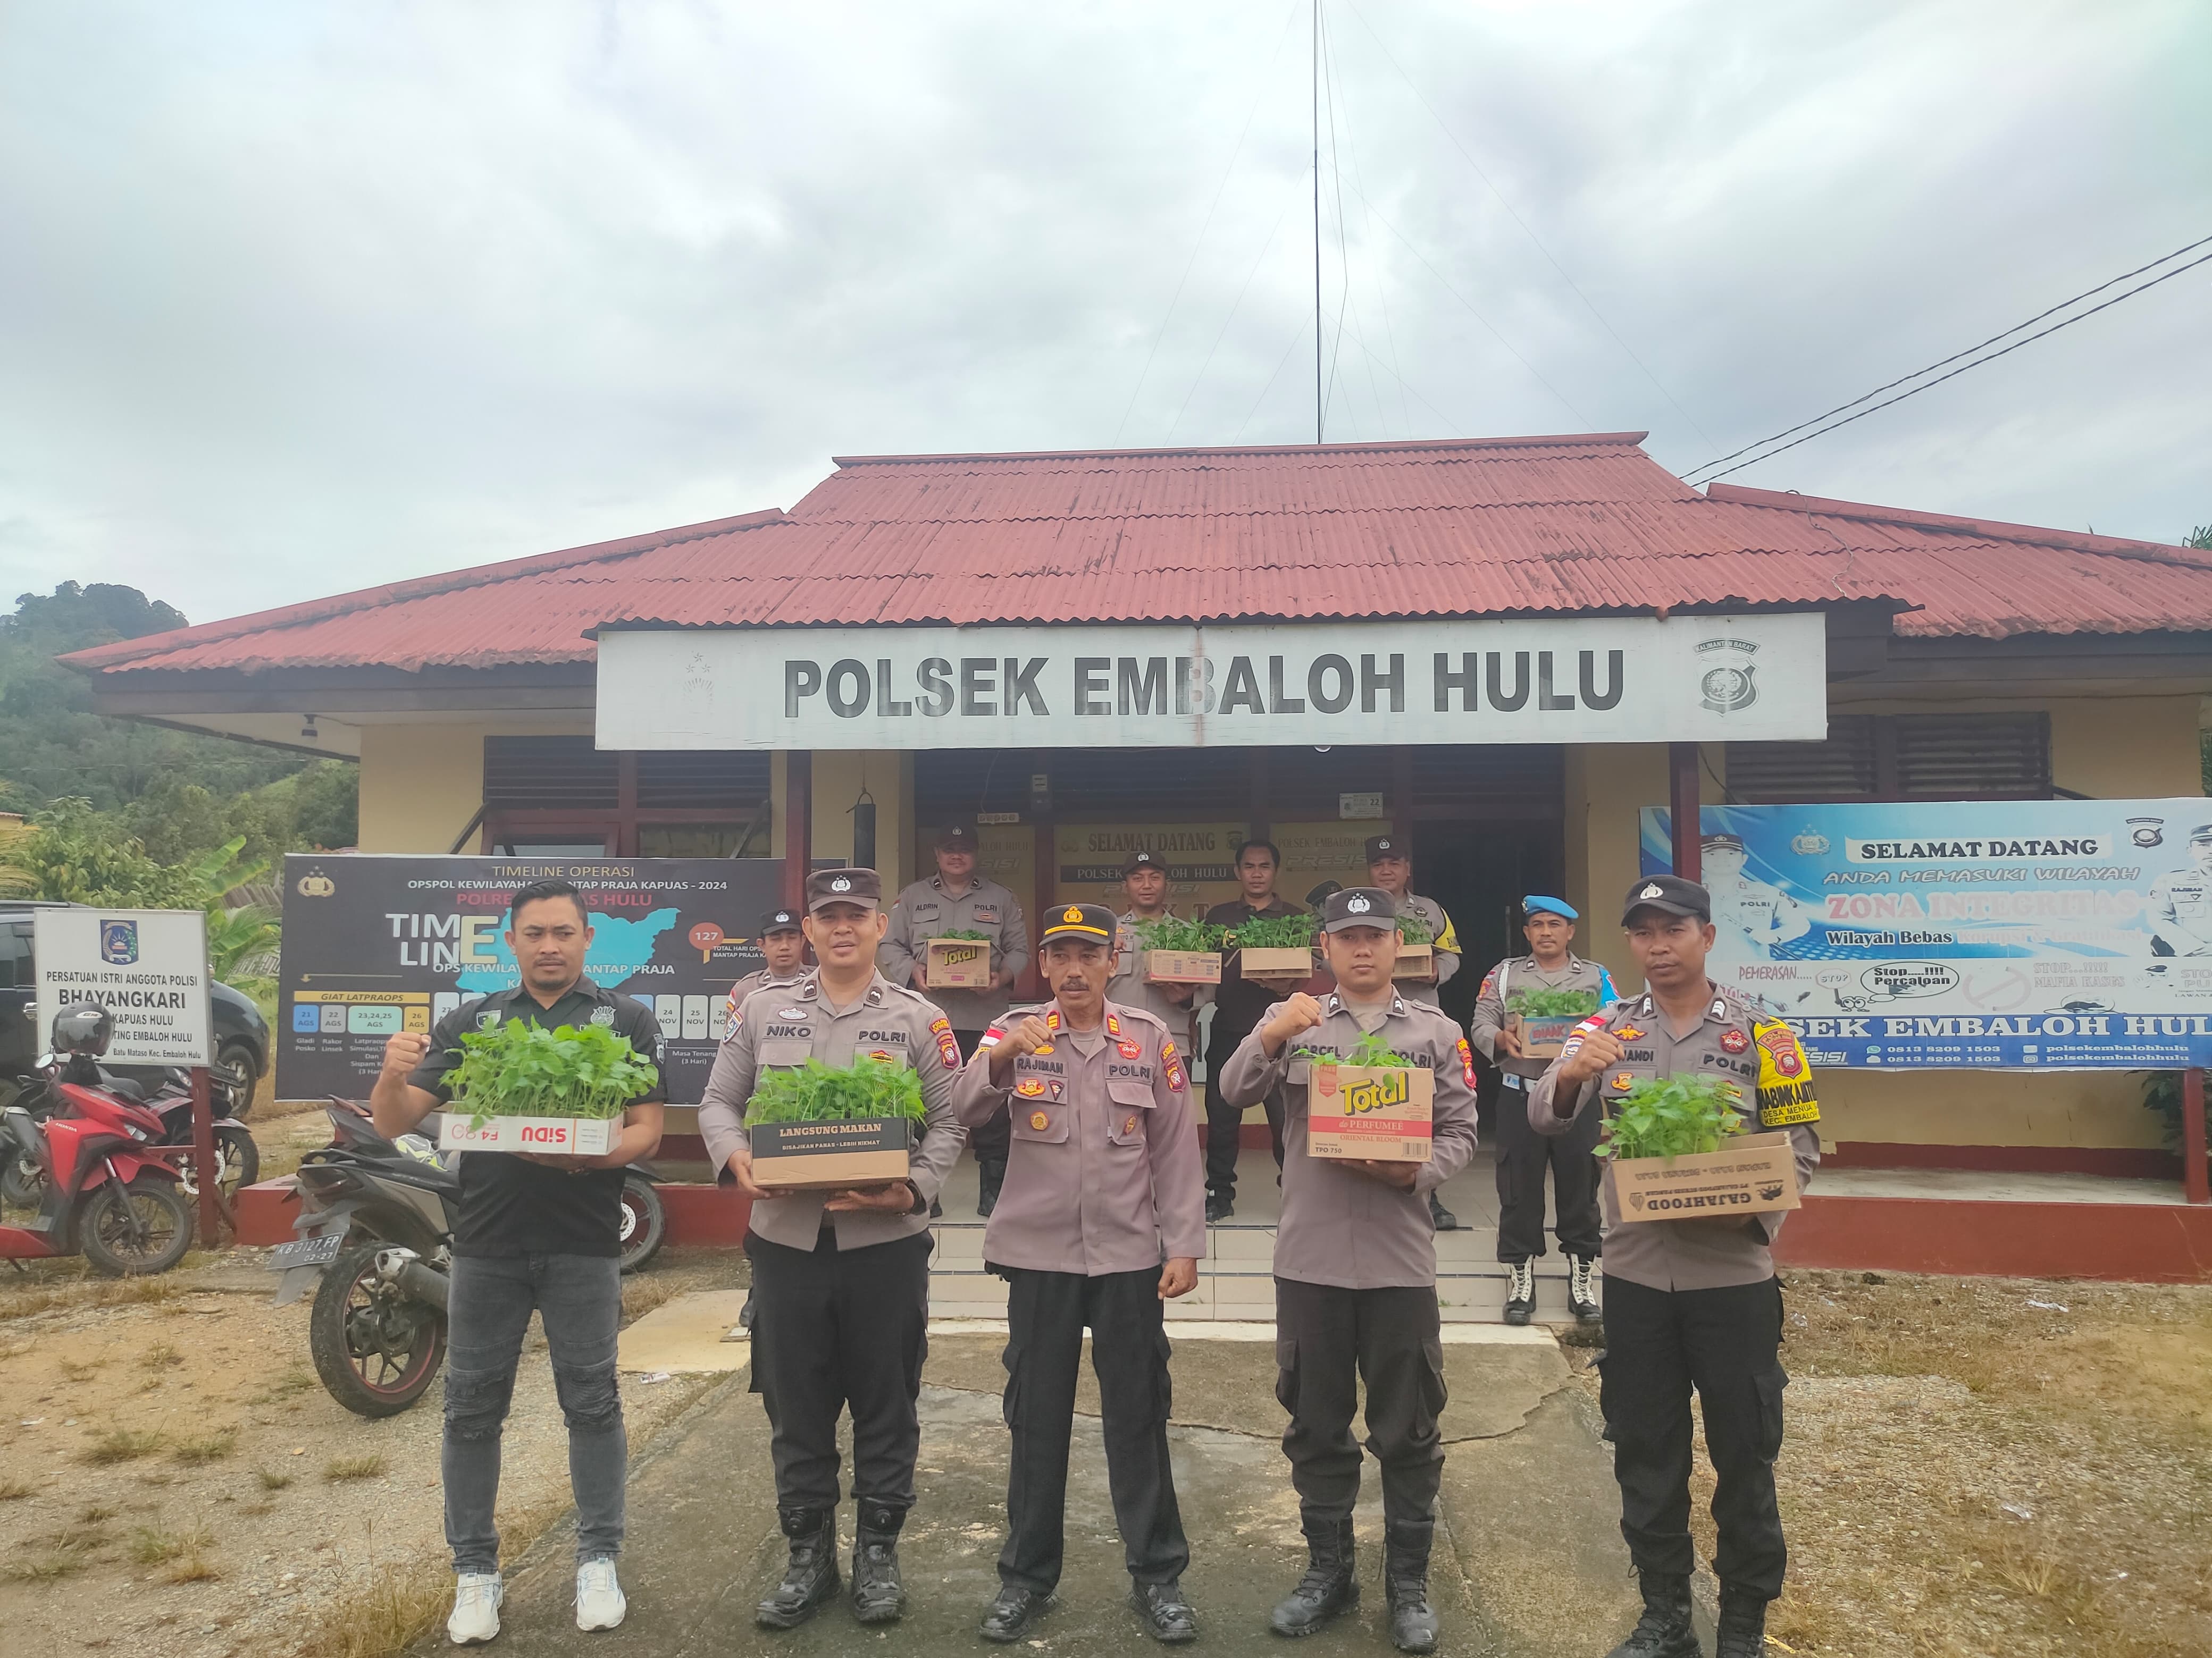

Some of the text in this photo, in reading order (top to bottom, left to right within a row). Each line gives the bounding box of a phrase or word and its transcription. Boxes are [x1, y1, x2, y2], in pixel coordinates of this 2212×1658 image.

[1733, 641, 1754, 651] BARAT
[785, 650, 1623, 719] POLSEK EMBALOH HULU
[1089, 832, 1215, 852] SELAMAT DATANG
[1861, 839, 2098, 859] SELAMAT DATANG
[1287, 854, 1366, 866] PRESIS
[492, 866, 635, 877] TIMELINE OPERASI
[1078, 869, 1123, 879] POLSEK
[1195, 868, 1227, 878] HULU
[1823, 867, 2141, 885] ANDA MEMASUKI WILAYAH
[408, 880, 455, 889] OPSPOL
[458, 880, 532, 889] KEWILAYAH
[601, 881, 638, 890] PRAJA
[641, 881, 689, 890] KAPUAS
[699, 881, 728, 890] 2024
[457, 893, 512, 905] POLRE
[604, 894, 652, 906] HULU
[1828, 891, 2139, 919] ZONA INTEGRITAS
[915, 903, 939, 912] ALDRIN
[695, 932, 718, 940] 127
[1828, 931, 1893, 946] Wilayah
[1900, 931, 1952, 944] Bebas
[942, 946, 977, 966] Total
[433, 964, 460, 973] OPS
[583, 965, 628, 974] ANTAP
[632, 965, 675, 974] PRAJA
[2181, 969, 2212, 979] STO
[47, 971, 198, 987] PERSATUAN ISTRI ANGGOTA POLISI
[1874, 977, 1950, 985] Percaloan
[60, 989, 186, 1009] BHAYANGKARI
[113, 1014, 174, 1026] KAPUAS HULU
[1784, 1015, 2212, 1037] SEK EMBALOH HUL
[113, 1031, 192, 1042] TING EMBALOH HULU
[766, 1025, 811, 1037] NIKO
[858, 1031, 906, 1042] POLRI
[113, 1048, 125, 1056] Batu
[163, 1050, 186, 1058] Embaloh
[188, 1050, 201, 1059] Hulu
[1017, 1057, 1063, 1074] RAJIMAN
[1109, 1064, 1151, 1079] POLRI
[1703, 1054, 1755, 1078] POLRI
[1339, 1071, 1410, 1116] Total
[1763, 1109, 1784, 1118] DESA
[1787, 1104, 1813, 1114] MENUA
[55, 1122, 77, 1133] HONDA
[521, 1126, 567, 1143] SiDU
[780, 1123, 882, 1138] LANGSUNG MAKAN
[481, 1131, 498, 1141] F4
[1647, 1192, 1752, 1211] GAJAHFOOD
[277, 1243, 294, 1255] KB
[323, 1235, 339, 1248] FP
